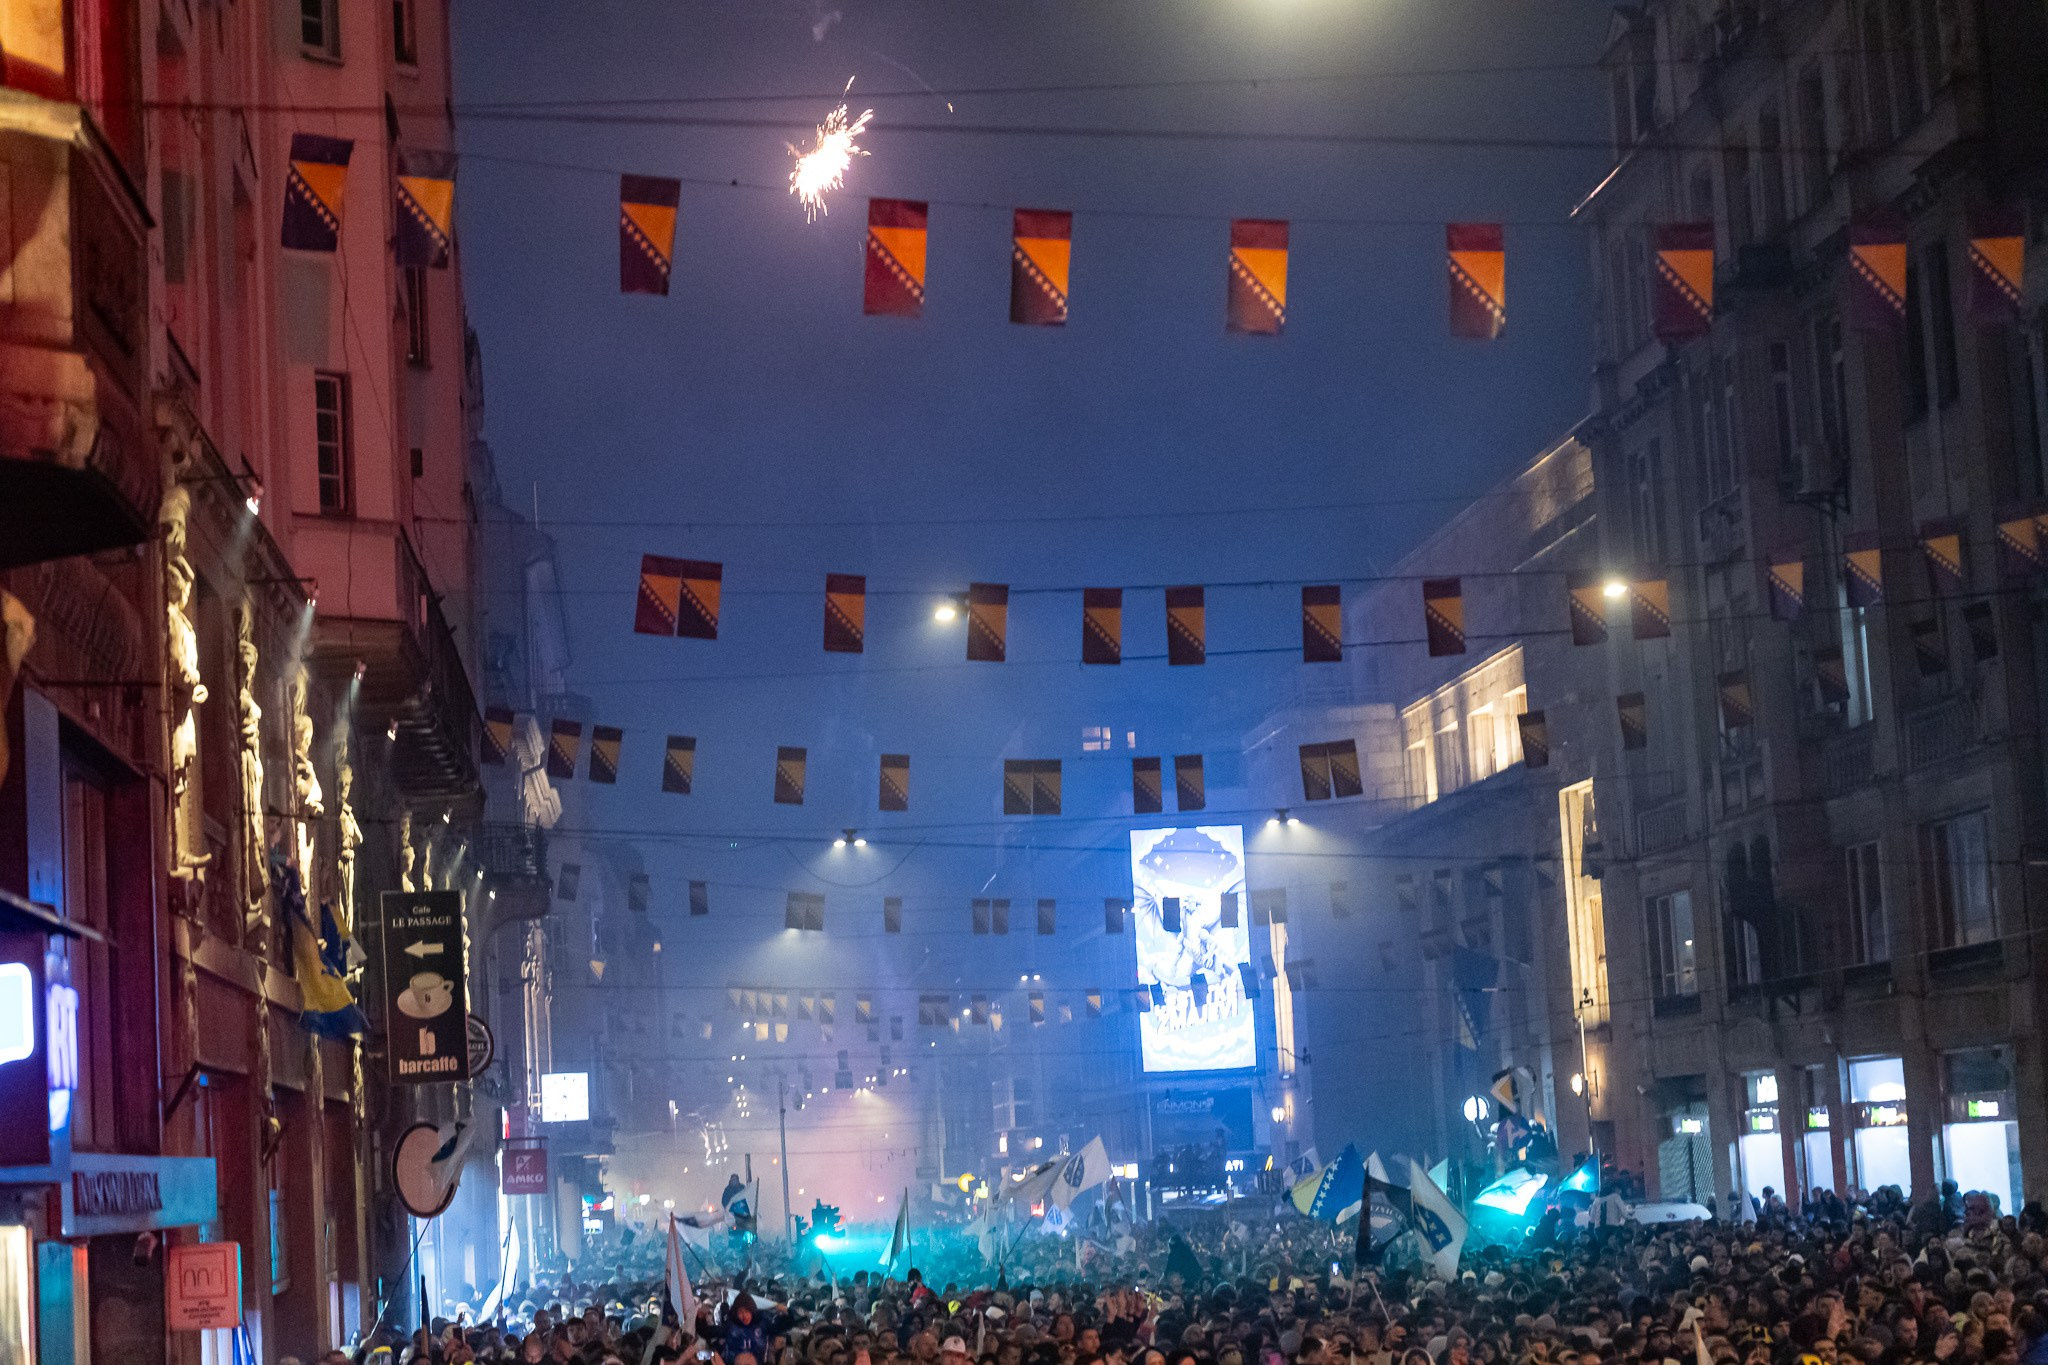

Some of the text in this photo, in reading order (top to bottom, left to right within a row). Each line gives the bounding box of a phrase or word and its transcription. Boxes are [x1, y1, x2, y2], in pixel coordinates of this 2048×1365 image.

[392, 915, 452, 928] LE PASSAGE
[506, 1173, 544, 1184] AMKO
